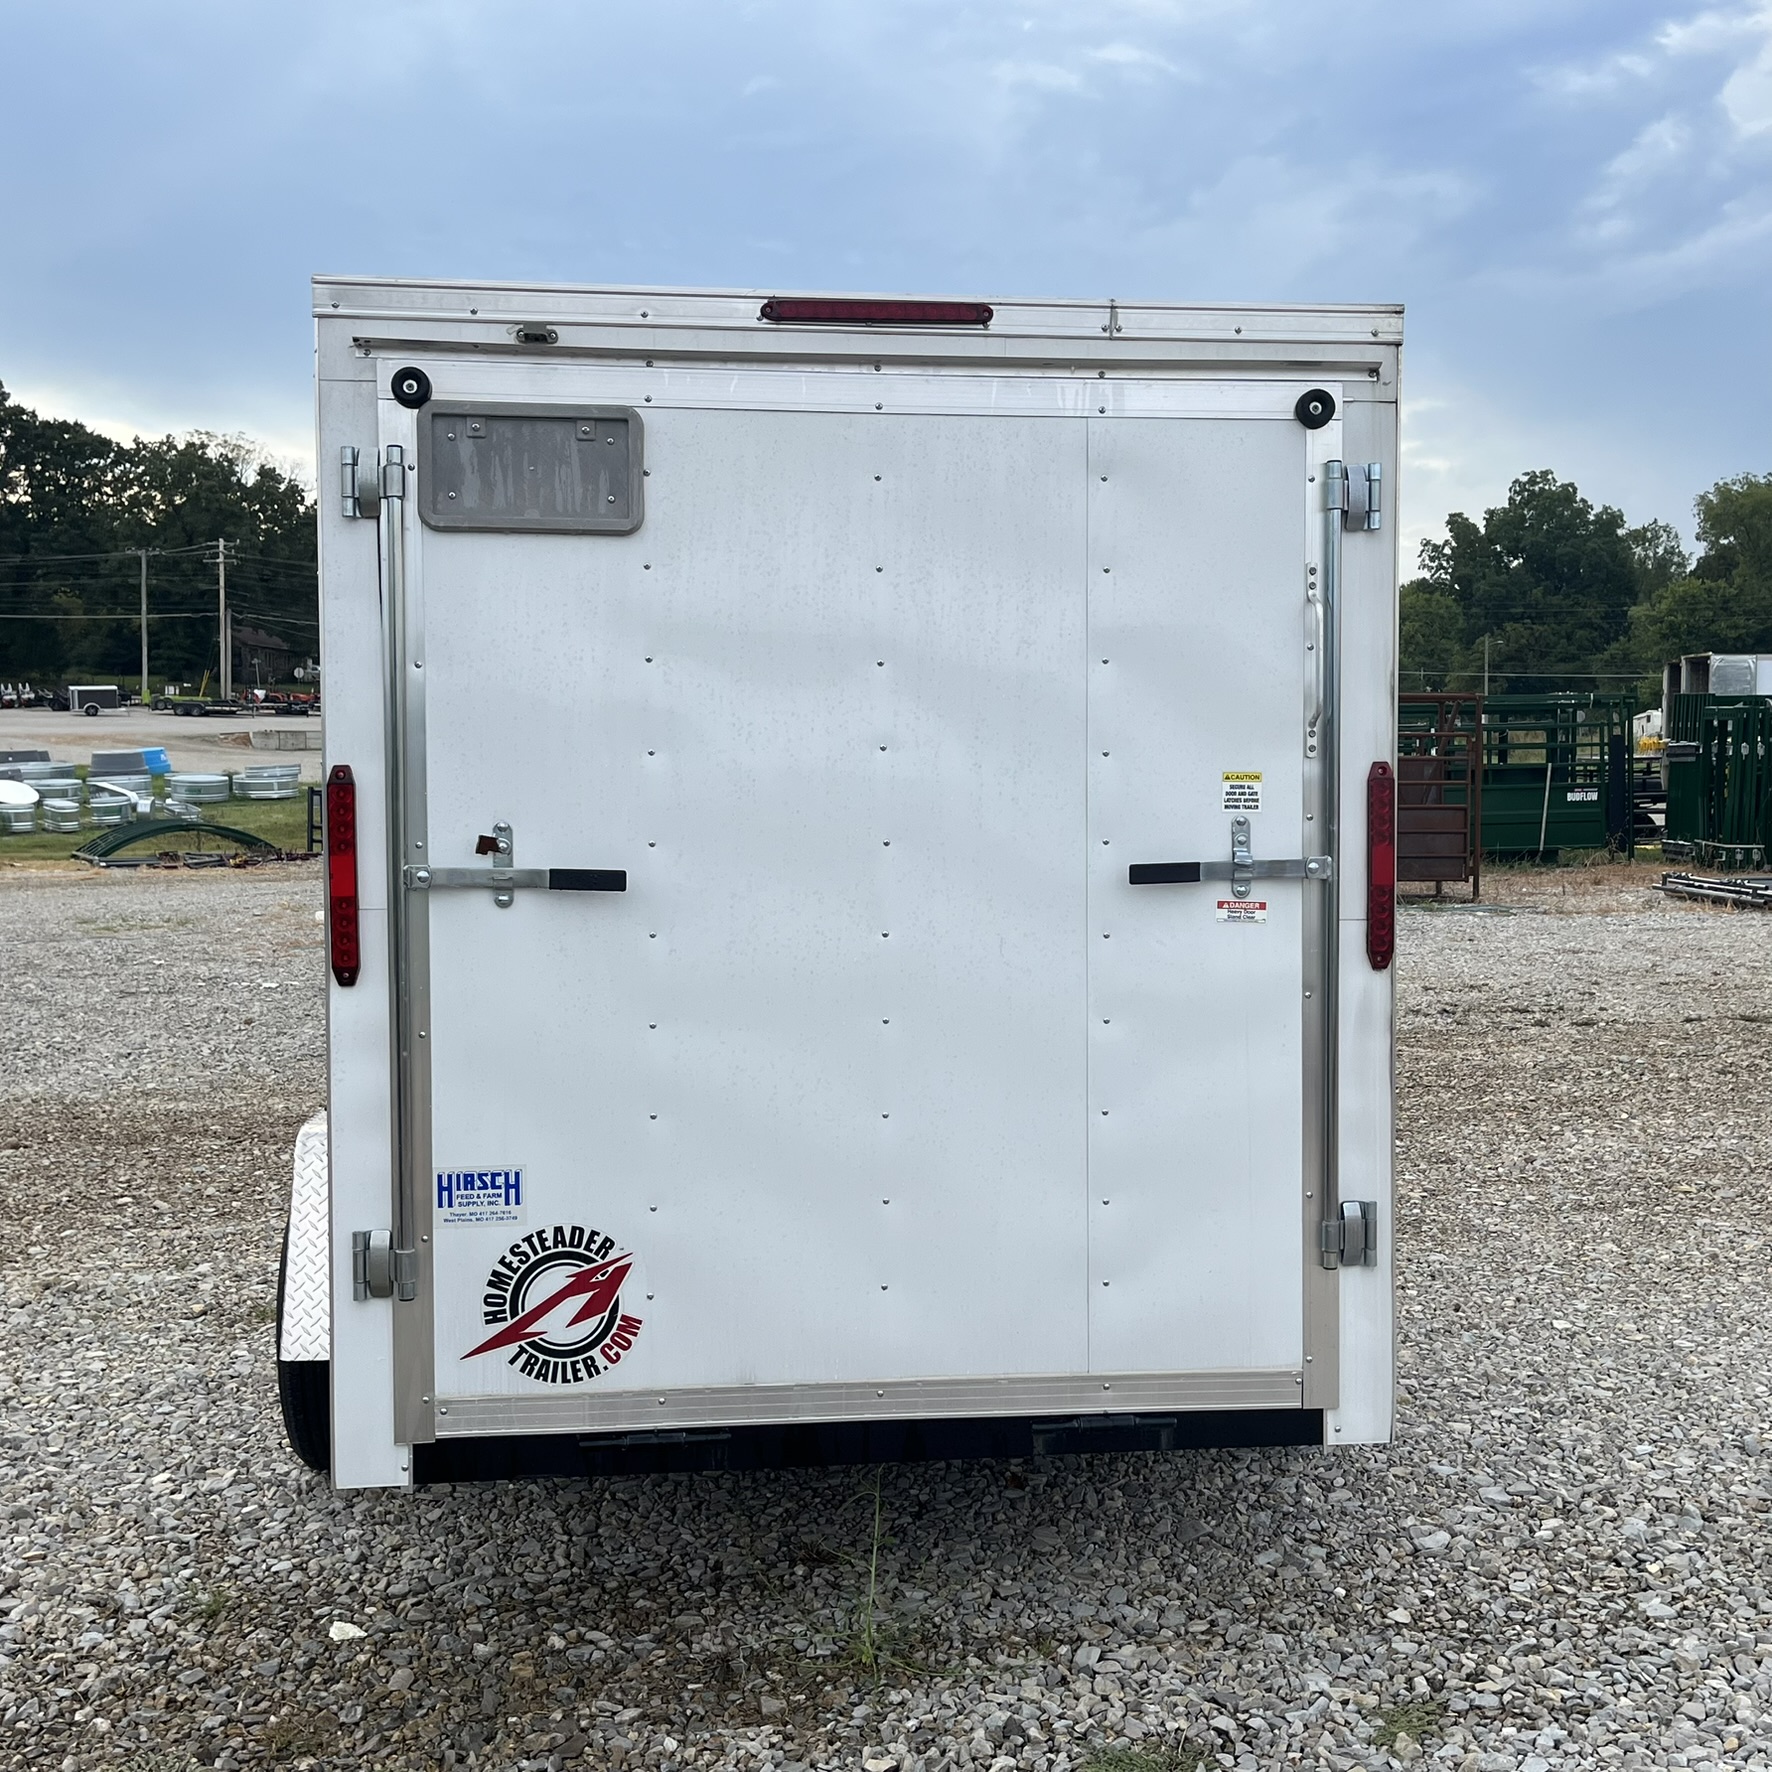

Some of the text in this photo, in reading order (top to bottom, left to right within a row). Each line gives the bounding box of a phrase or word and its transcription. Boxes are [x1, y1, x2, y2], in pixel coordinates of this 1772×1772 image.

[1566, 792, 1598, 801] BUDFLOW
[437, 1169, 522, 1208] HIRSCH
[483, 1225, 616, 1326] HOMESTEADER
